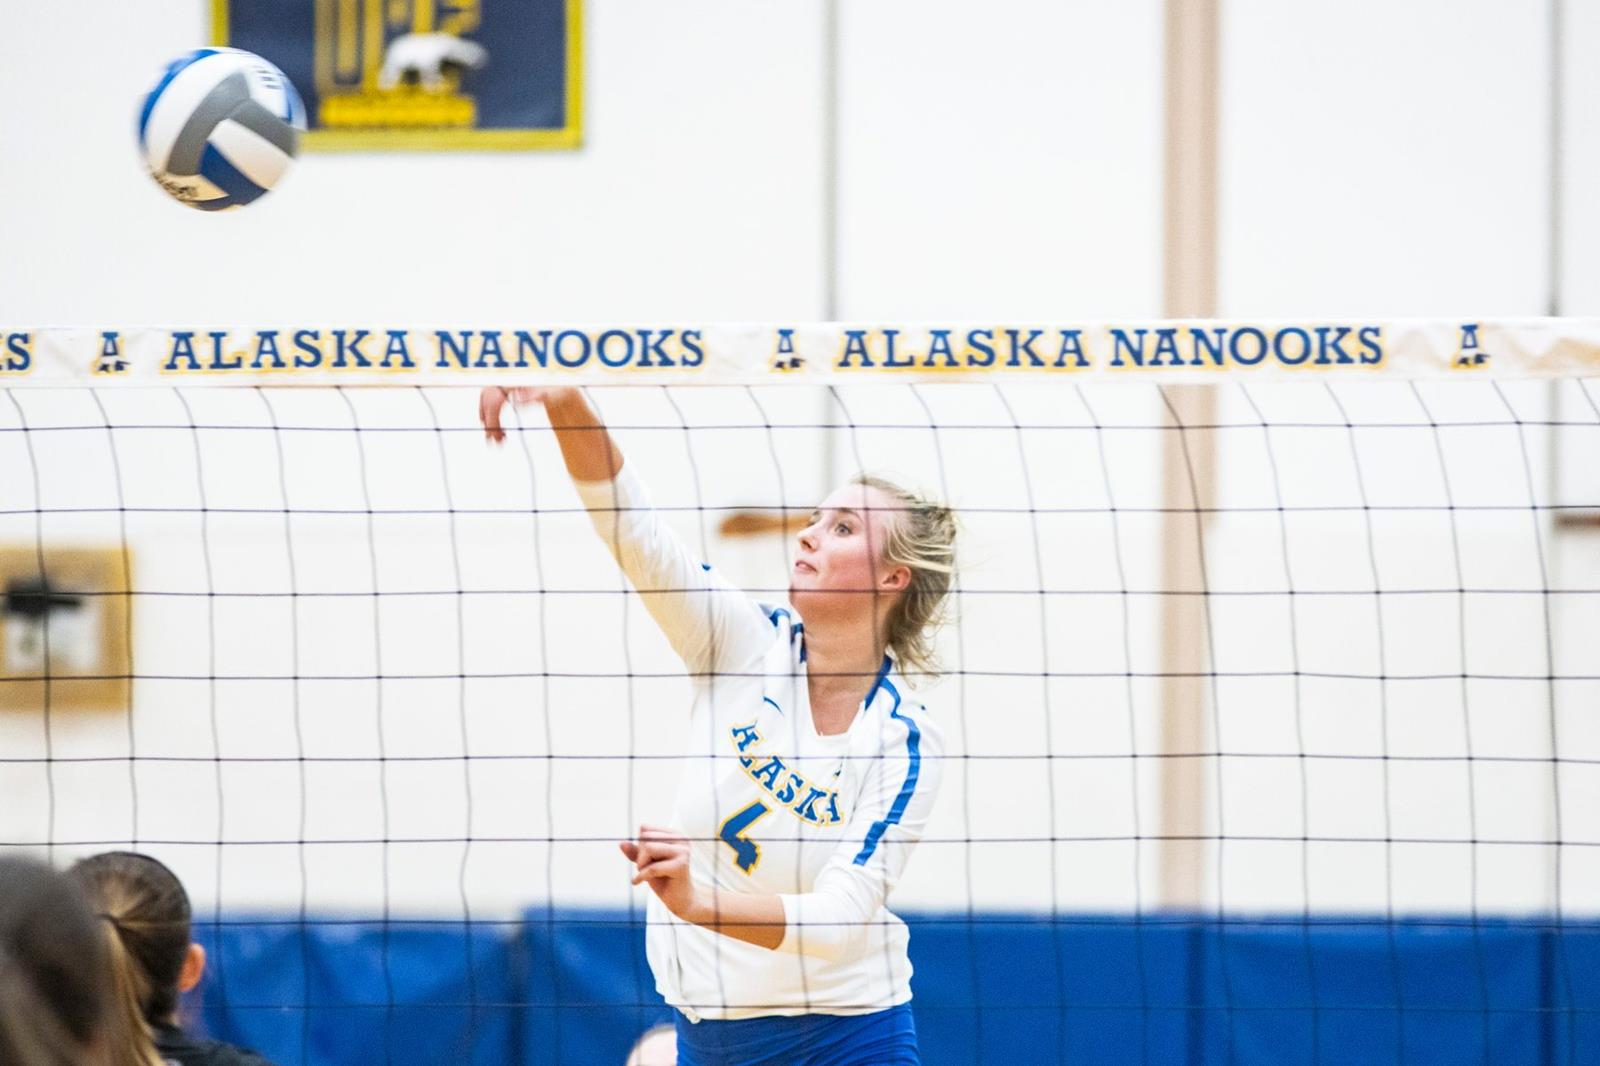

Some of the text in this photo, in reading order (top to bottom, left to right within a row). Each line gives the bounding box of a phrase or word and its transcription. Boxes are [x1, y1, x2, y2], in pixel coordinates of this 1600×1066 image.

[164, 329, 705, 370] ALASKA NANOOKS
[837, 327, 1383, 368] ALASKA NANOOKS
[718, 799, 772, 875] 4
